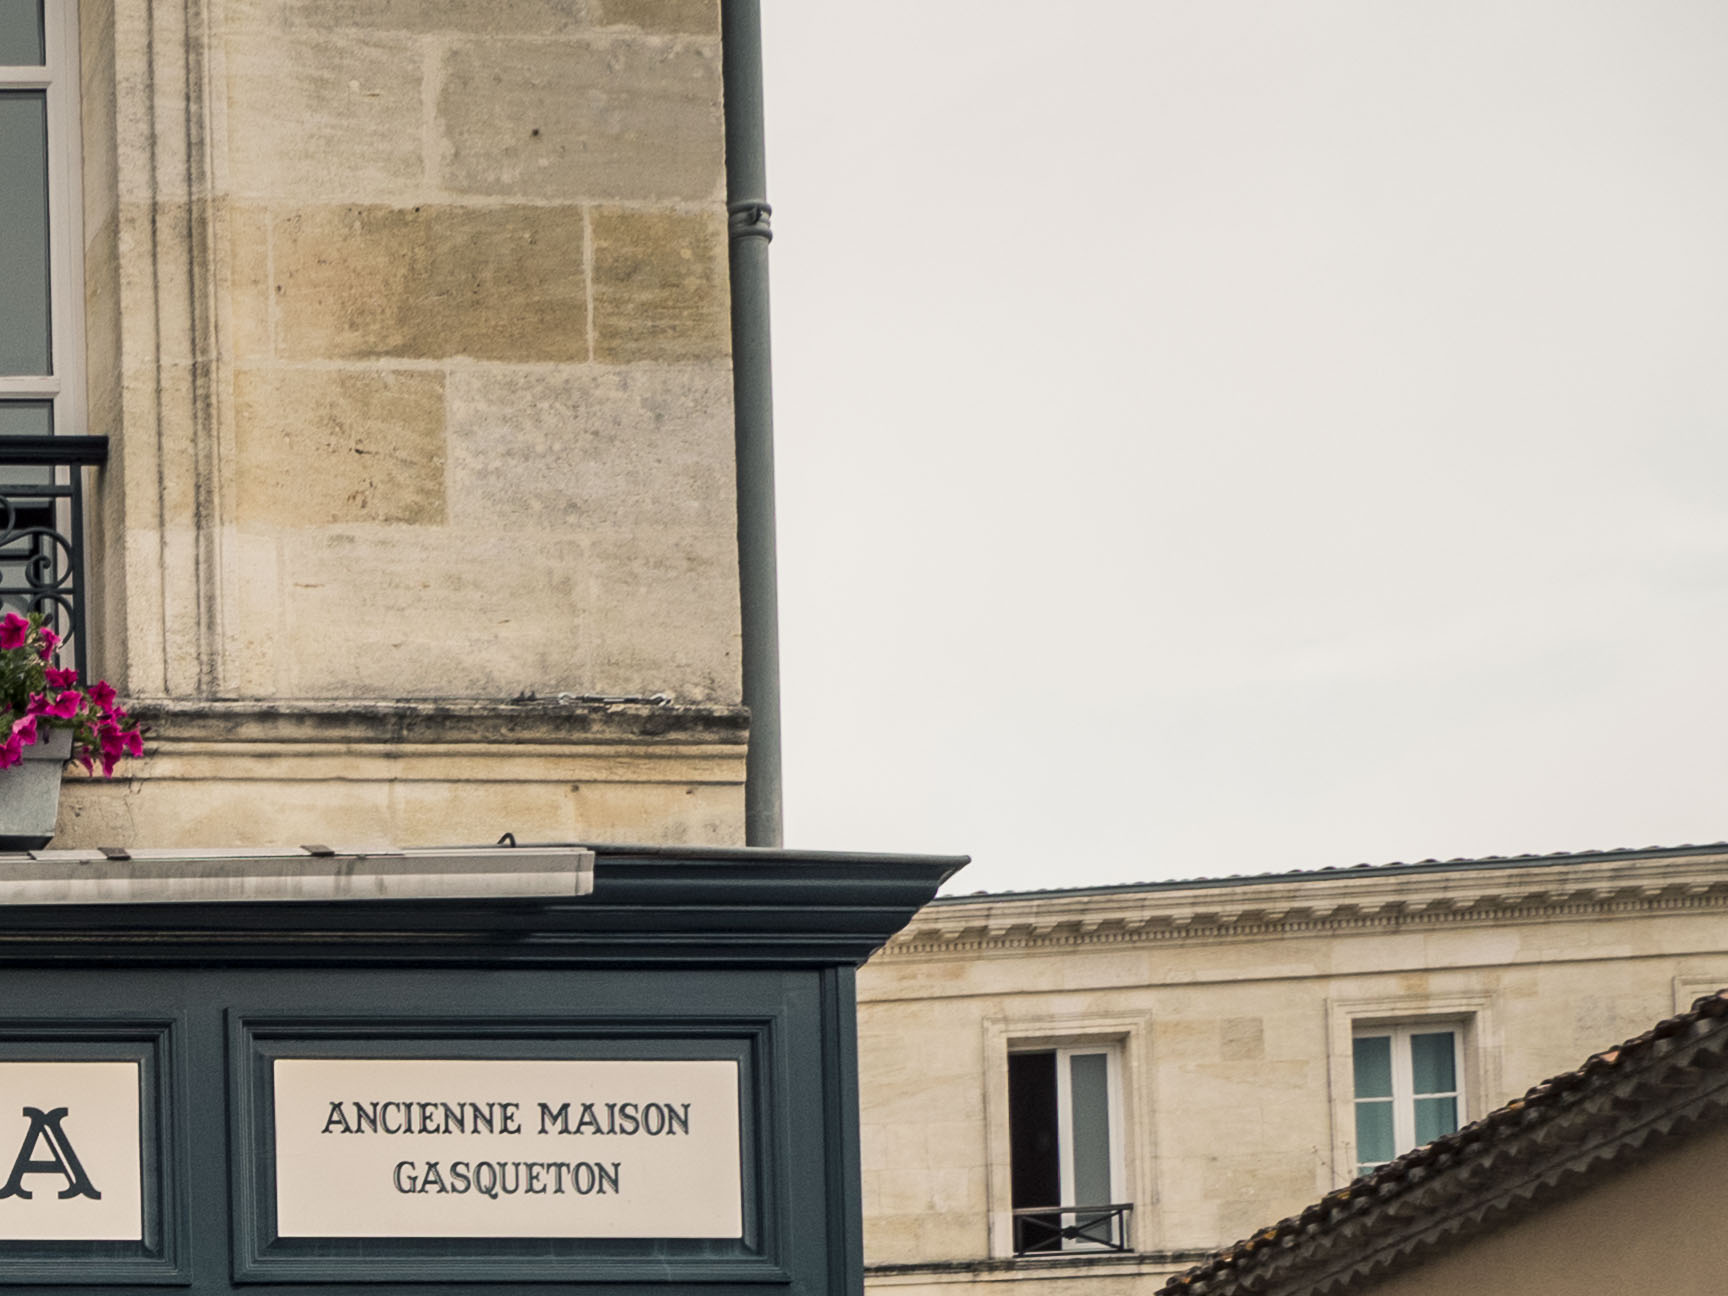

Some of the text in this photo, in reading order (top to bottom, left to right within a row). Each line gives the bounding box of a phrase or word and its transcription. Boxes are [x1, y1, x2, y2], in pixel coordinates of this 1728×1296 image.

[321, 1101, 691, 1136] ANCIENNE MAISON
[393, 1160, 622, 1200] GASQUETON
